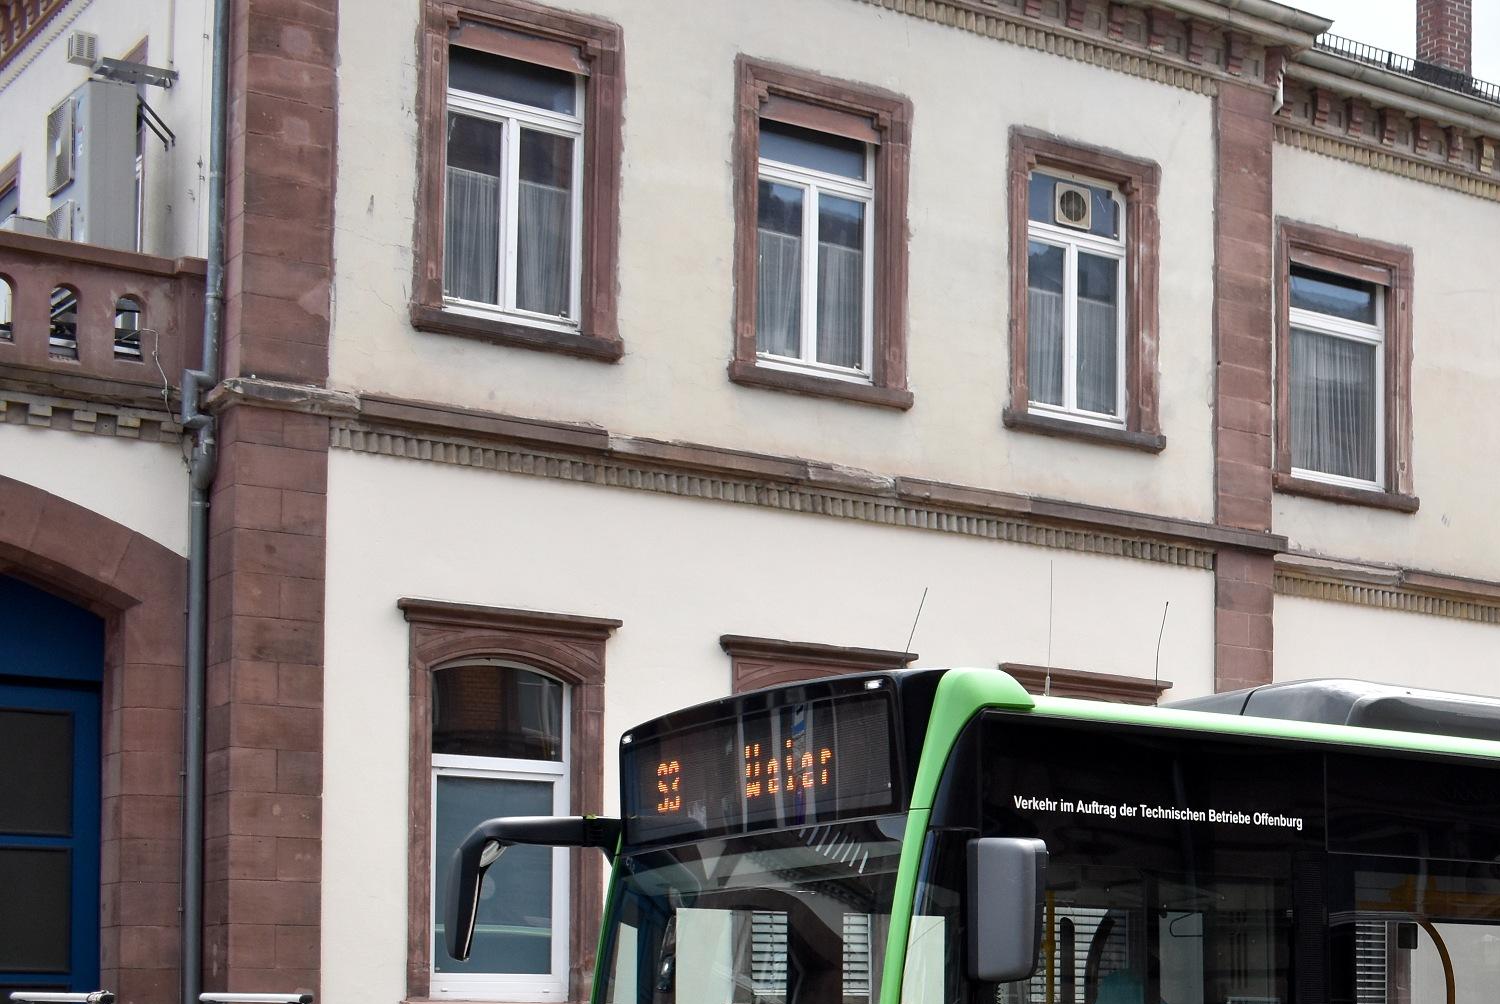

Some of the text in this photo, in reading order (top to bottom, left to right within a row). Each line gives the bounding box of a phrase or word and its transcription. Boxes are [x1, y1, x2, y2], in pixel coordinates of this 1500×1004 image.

[657, 739, 832, 813] S3 Weier
[1013, 795, 1303, 831] Verkehr im Auftrag der Technischen Betriebe Offenburg
